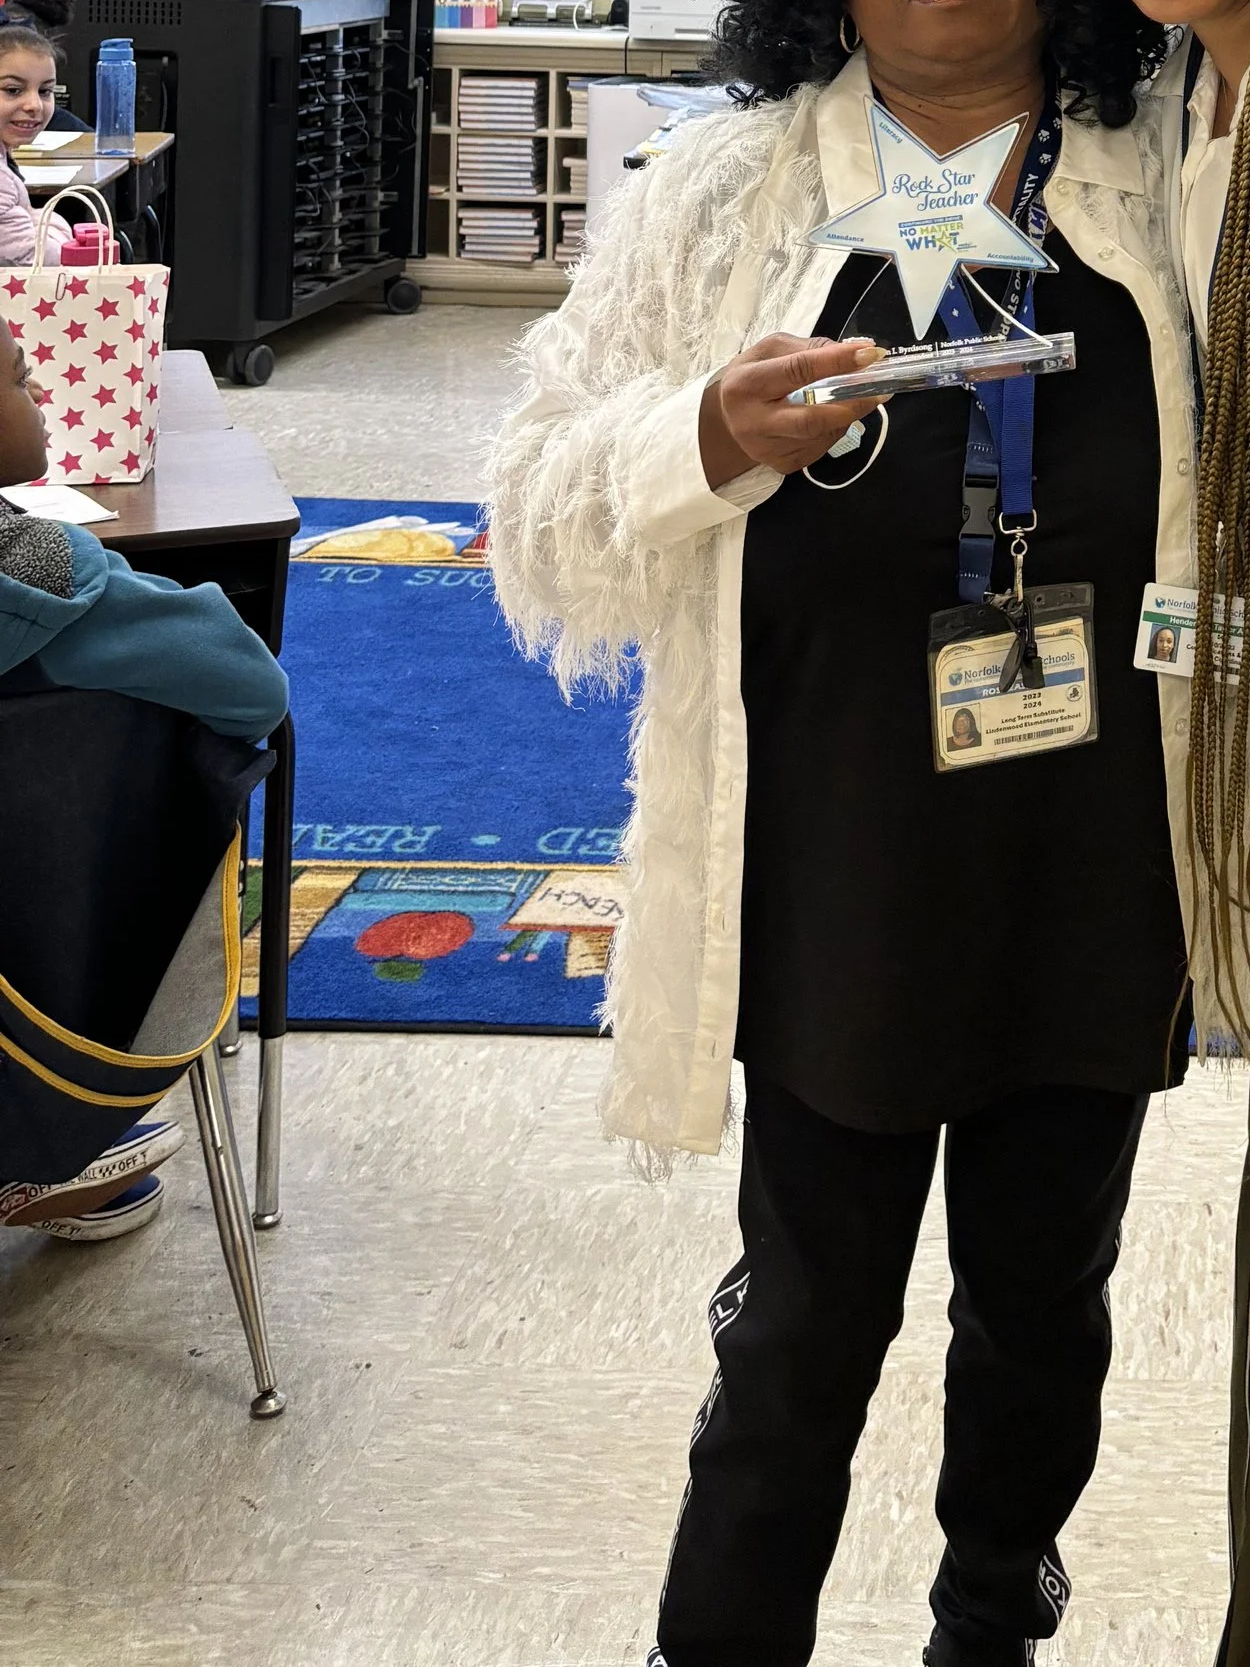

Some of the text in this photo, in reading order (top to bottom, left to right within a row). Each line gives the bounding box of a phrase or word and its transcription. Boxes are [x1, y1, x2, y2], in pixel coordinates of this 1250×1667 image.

[879, 122, 903, 144] Literacy
[892, 169, 975, 198] Rock Star
[917, 191, 978, 211] Teacher
[899, 228, 917, 237] NO
[920, 222, 964, 235] MATTER
[826, 233, 864, 242] Attendance
[987, 252, 1034, 263] Accountability
[899, 343, 933, 355] Byrdsong
[941, 340, 963, 348] Norfolk
[964, 336, 982, 345] Public
[317, 566, 383, 584] TO
[964, 665, 1001, 680] Norfolk
[1022, 692, 1042, 701] 2023
[1023, 701, 1042, 709] 2024
[986, 712, 1081, 734] Lindenwood Elementary School
[1001, 716, 1016, 724] Long
[1033, 708, 1065, 718] Substitute
[118, 1158, 138, 1172] OFF
[77, 1168, 96, 1183] WALL
[42, 1220, 65, 1232] OFF
